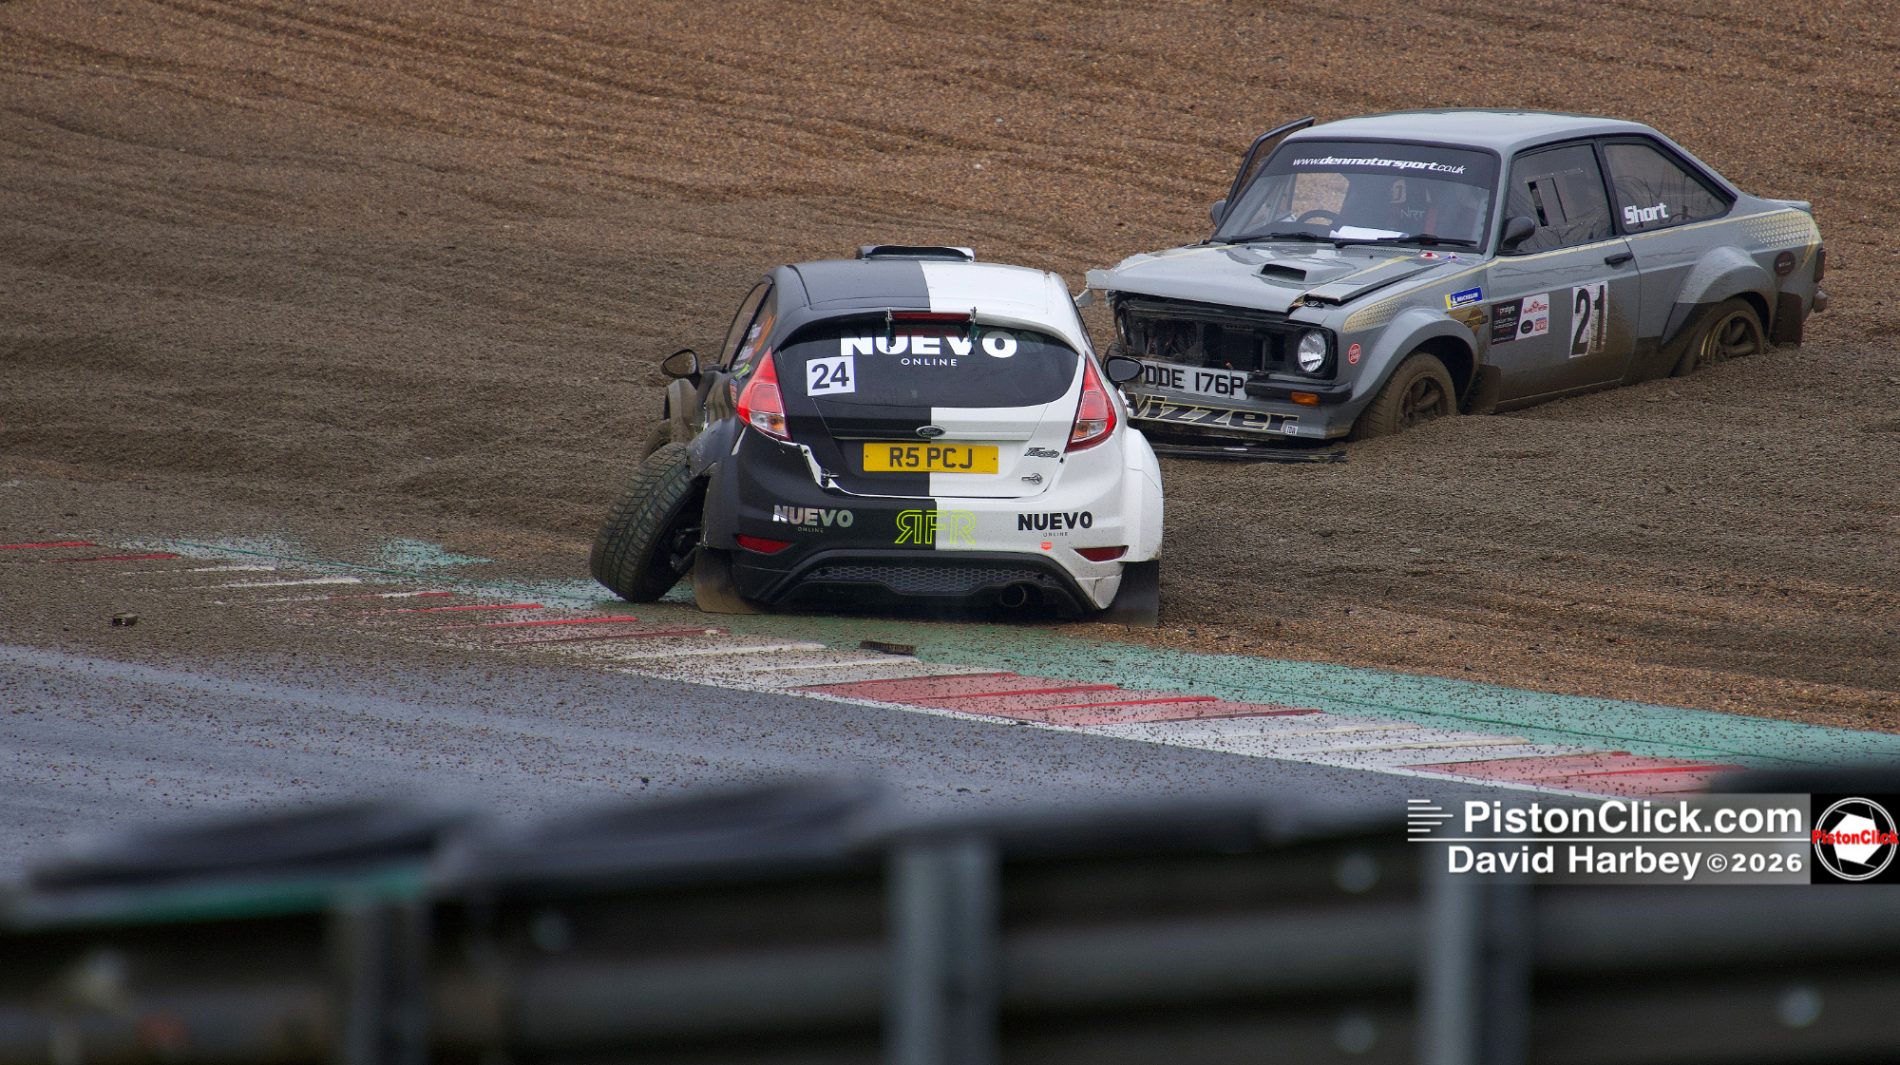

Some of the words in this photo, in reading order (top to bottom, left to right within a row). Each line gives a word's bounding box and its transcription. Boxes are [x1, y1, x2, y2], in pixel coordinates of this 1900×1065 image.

[1292, 156, 1467, 174] www.denmotorsport.co.uk
[1624, 202, 1669, 225] Short
[1572, 285, 1605, 355] 21
[841, 331, 1018, 358] NUEVO
[901, 357, 957, 366] ONLINE
[811, 361, 849, 390] 24
[1145, 365, 1185, 389] DDE
[1195, 370, 1244, 395] 176P
[889, 447, 920, 468] R5
[927, 447, 973, 469] PCJ
[772, 505, 854, 527] NUEVO
[1018, 511, 1093, 530] NUEVO
[797, 526, 825, 534] ONLINE
